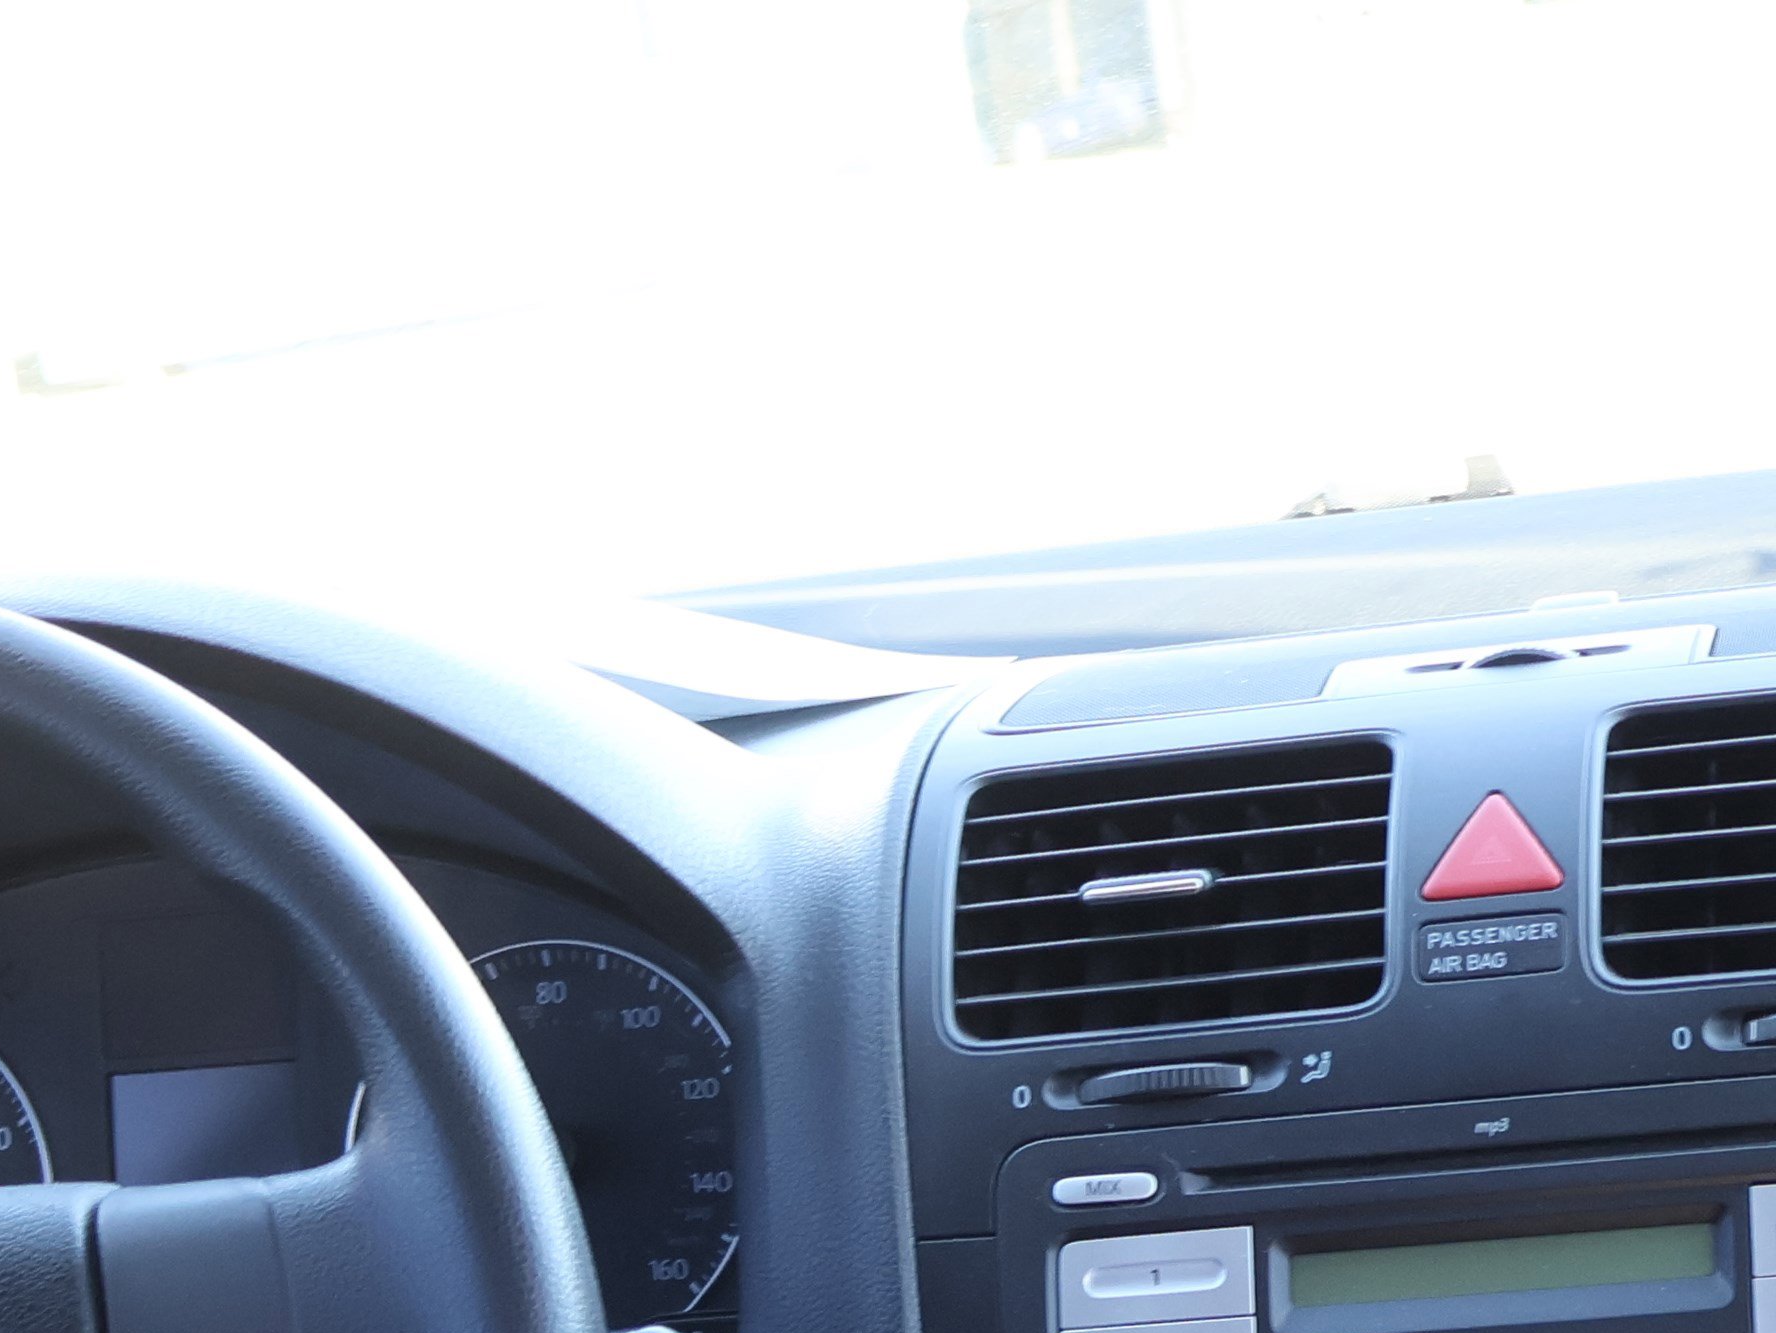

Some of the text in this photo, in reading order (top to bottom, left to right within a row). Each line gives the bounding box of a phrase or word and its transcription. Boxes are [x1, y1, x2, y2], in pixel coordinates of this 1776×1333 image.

[1427, 922, 1558, 949] PASSENGER
[1428, 951, 1508, 975] AIR BAG
[536, 981, 567, 1004] 80
[621, 1006, 661, 1028] 100
[681, 1078, 720, 1099] 120
[689, 1171, 733, 1193] 140
[647, 1259, 689, 1280] 160
[1150, 1268, 1160, 1286] 1
